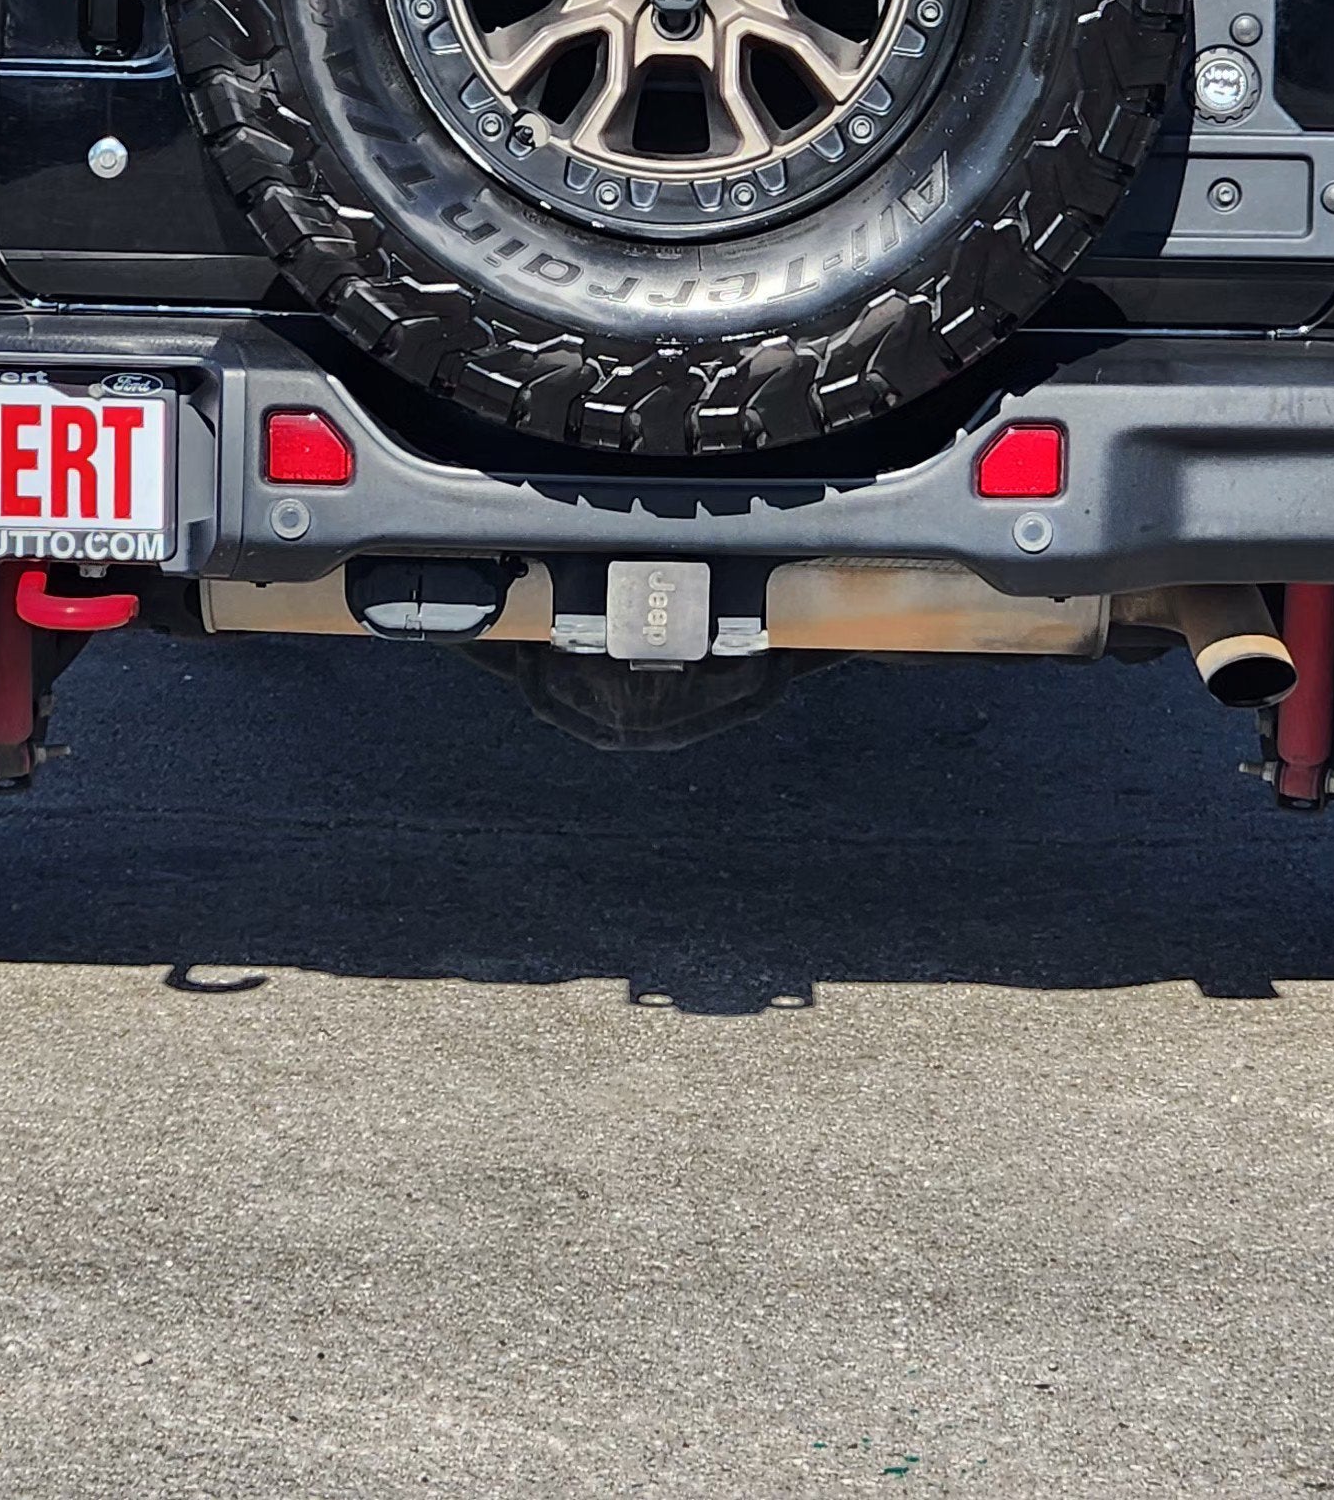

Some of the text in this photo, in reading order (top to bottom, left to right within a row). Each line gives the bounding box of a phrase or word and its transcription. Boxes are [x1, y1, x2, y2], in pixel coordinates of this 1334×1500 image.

[1205, 66, 1239, 83] Jeep
[322, 51, 435, 201] T/A
[438, 149, 950, 308] All-Terrain
[112, 376, 151, 394] Ford
[642, 571, 676, 646] Jeep
